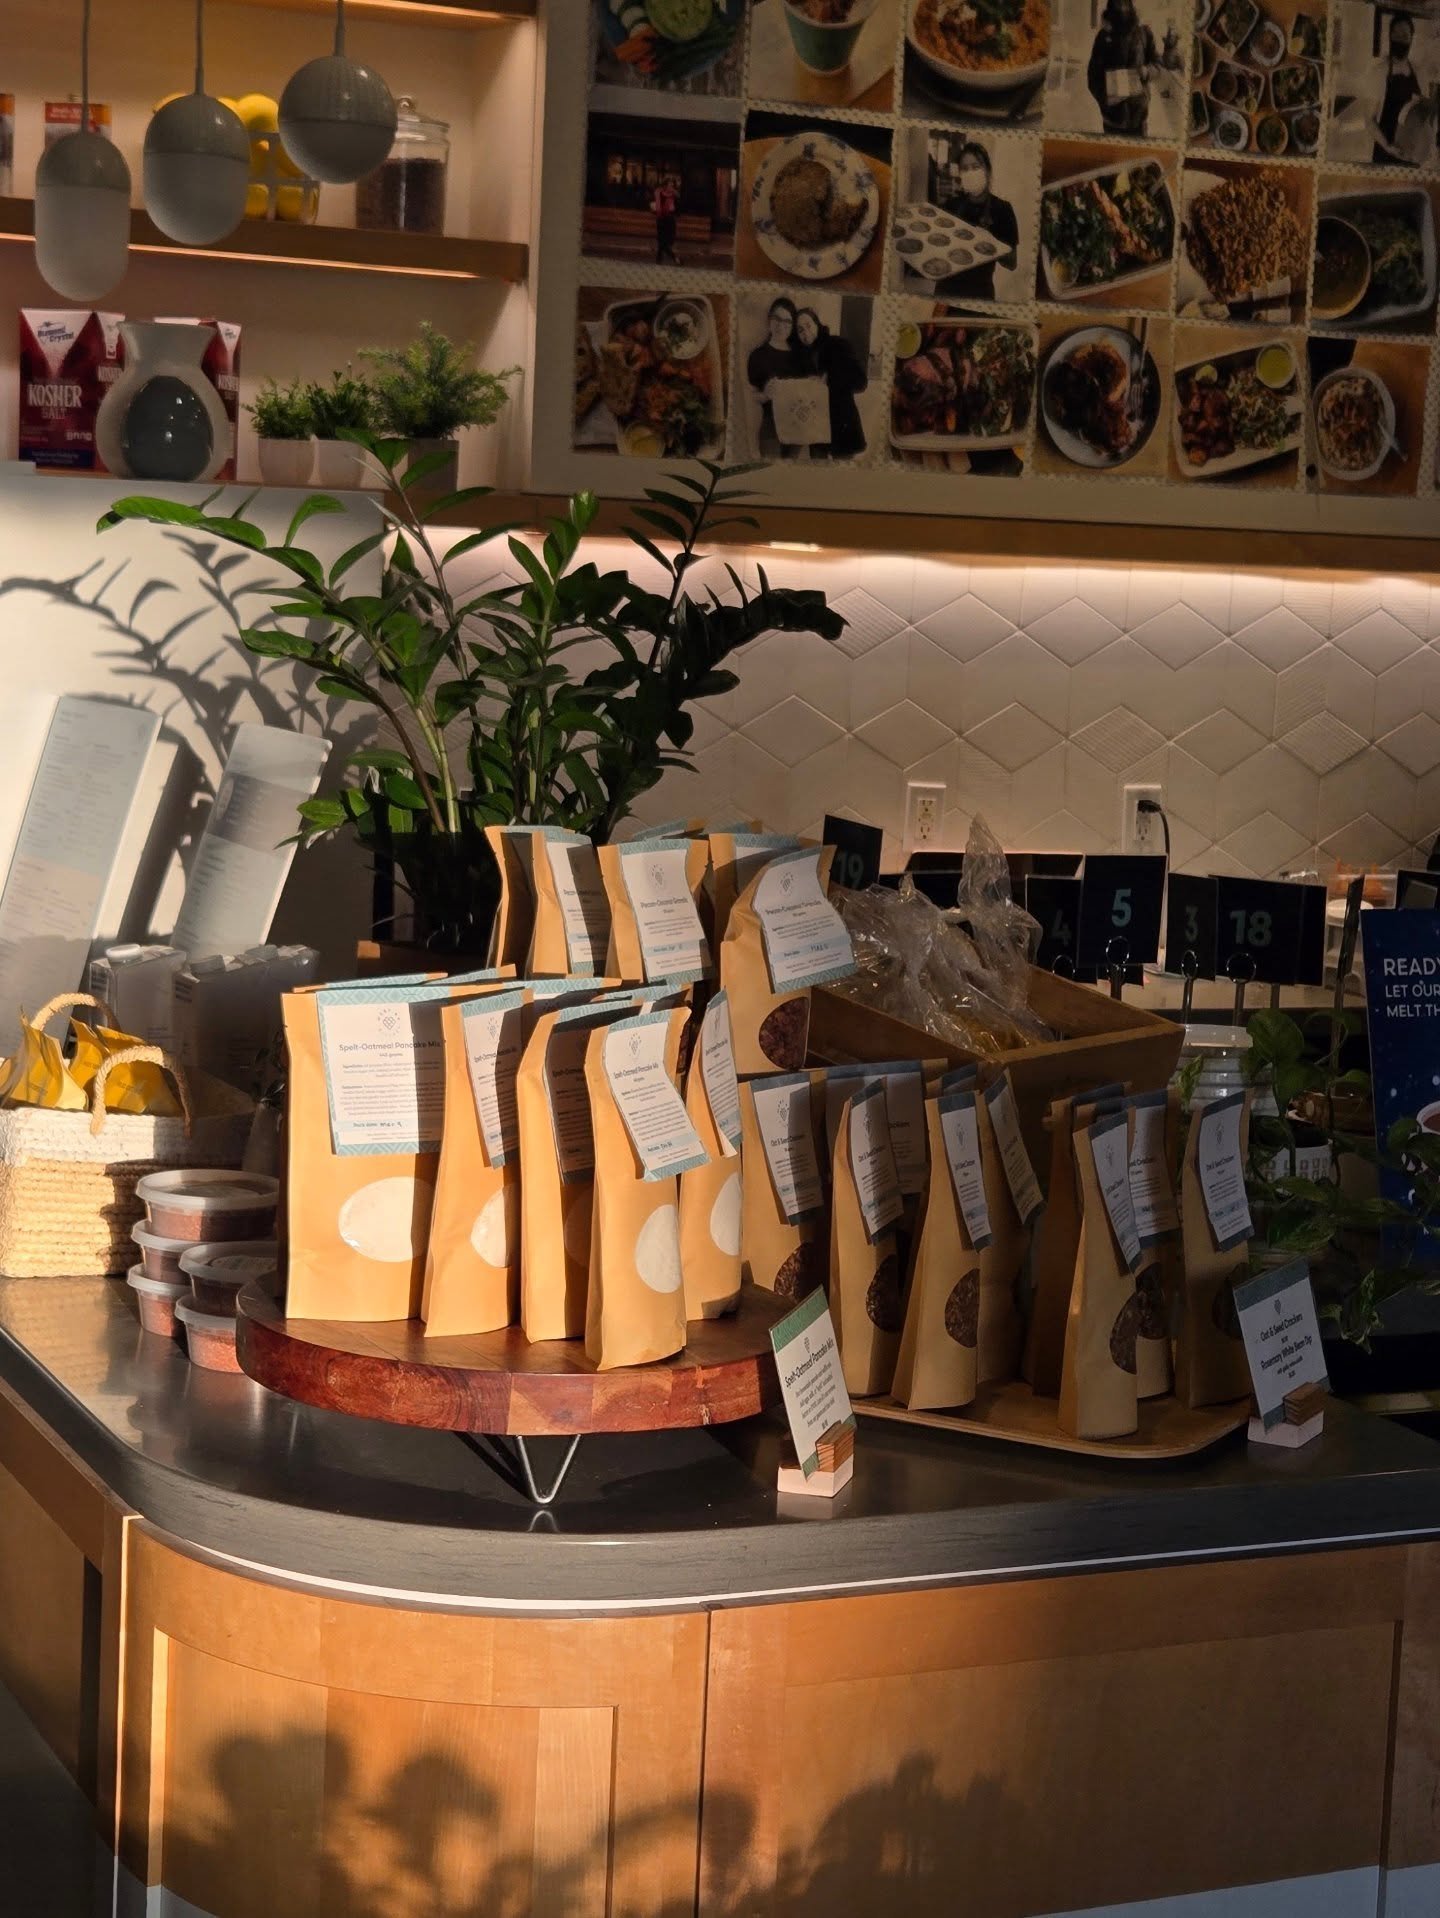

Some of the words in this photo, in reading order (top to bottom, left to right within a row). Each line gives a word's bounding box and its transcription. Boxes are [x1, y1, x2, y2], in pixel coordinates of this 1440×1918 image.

[28, 383, 83, 409] KOSHER
[41, 406, 68, 420] SALT
[837, 851, 865, 889] 19
[1110, 888, 1132, 929] 5
[1183, 907, 1199, 942] 3
[1051, 908, 1072, 947] 4
[1229, 909, 1273, 947] 18
[1385, 984, 1409, 998] LET
[1412, 982, 1440, 998] OUR
[1386, 1003, 1422, 1018] MELT
[339, 1042, 394, 1053] Spelt-Oatmeal
[395, 1040, 427, 1050] Pancake
[428, 1040, 441, 1049] Mix
[784, 1355, 812, 1389] Spelt-Oatmeal
